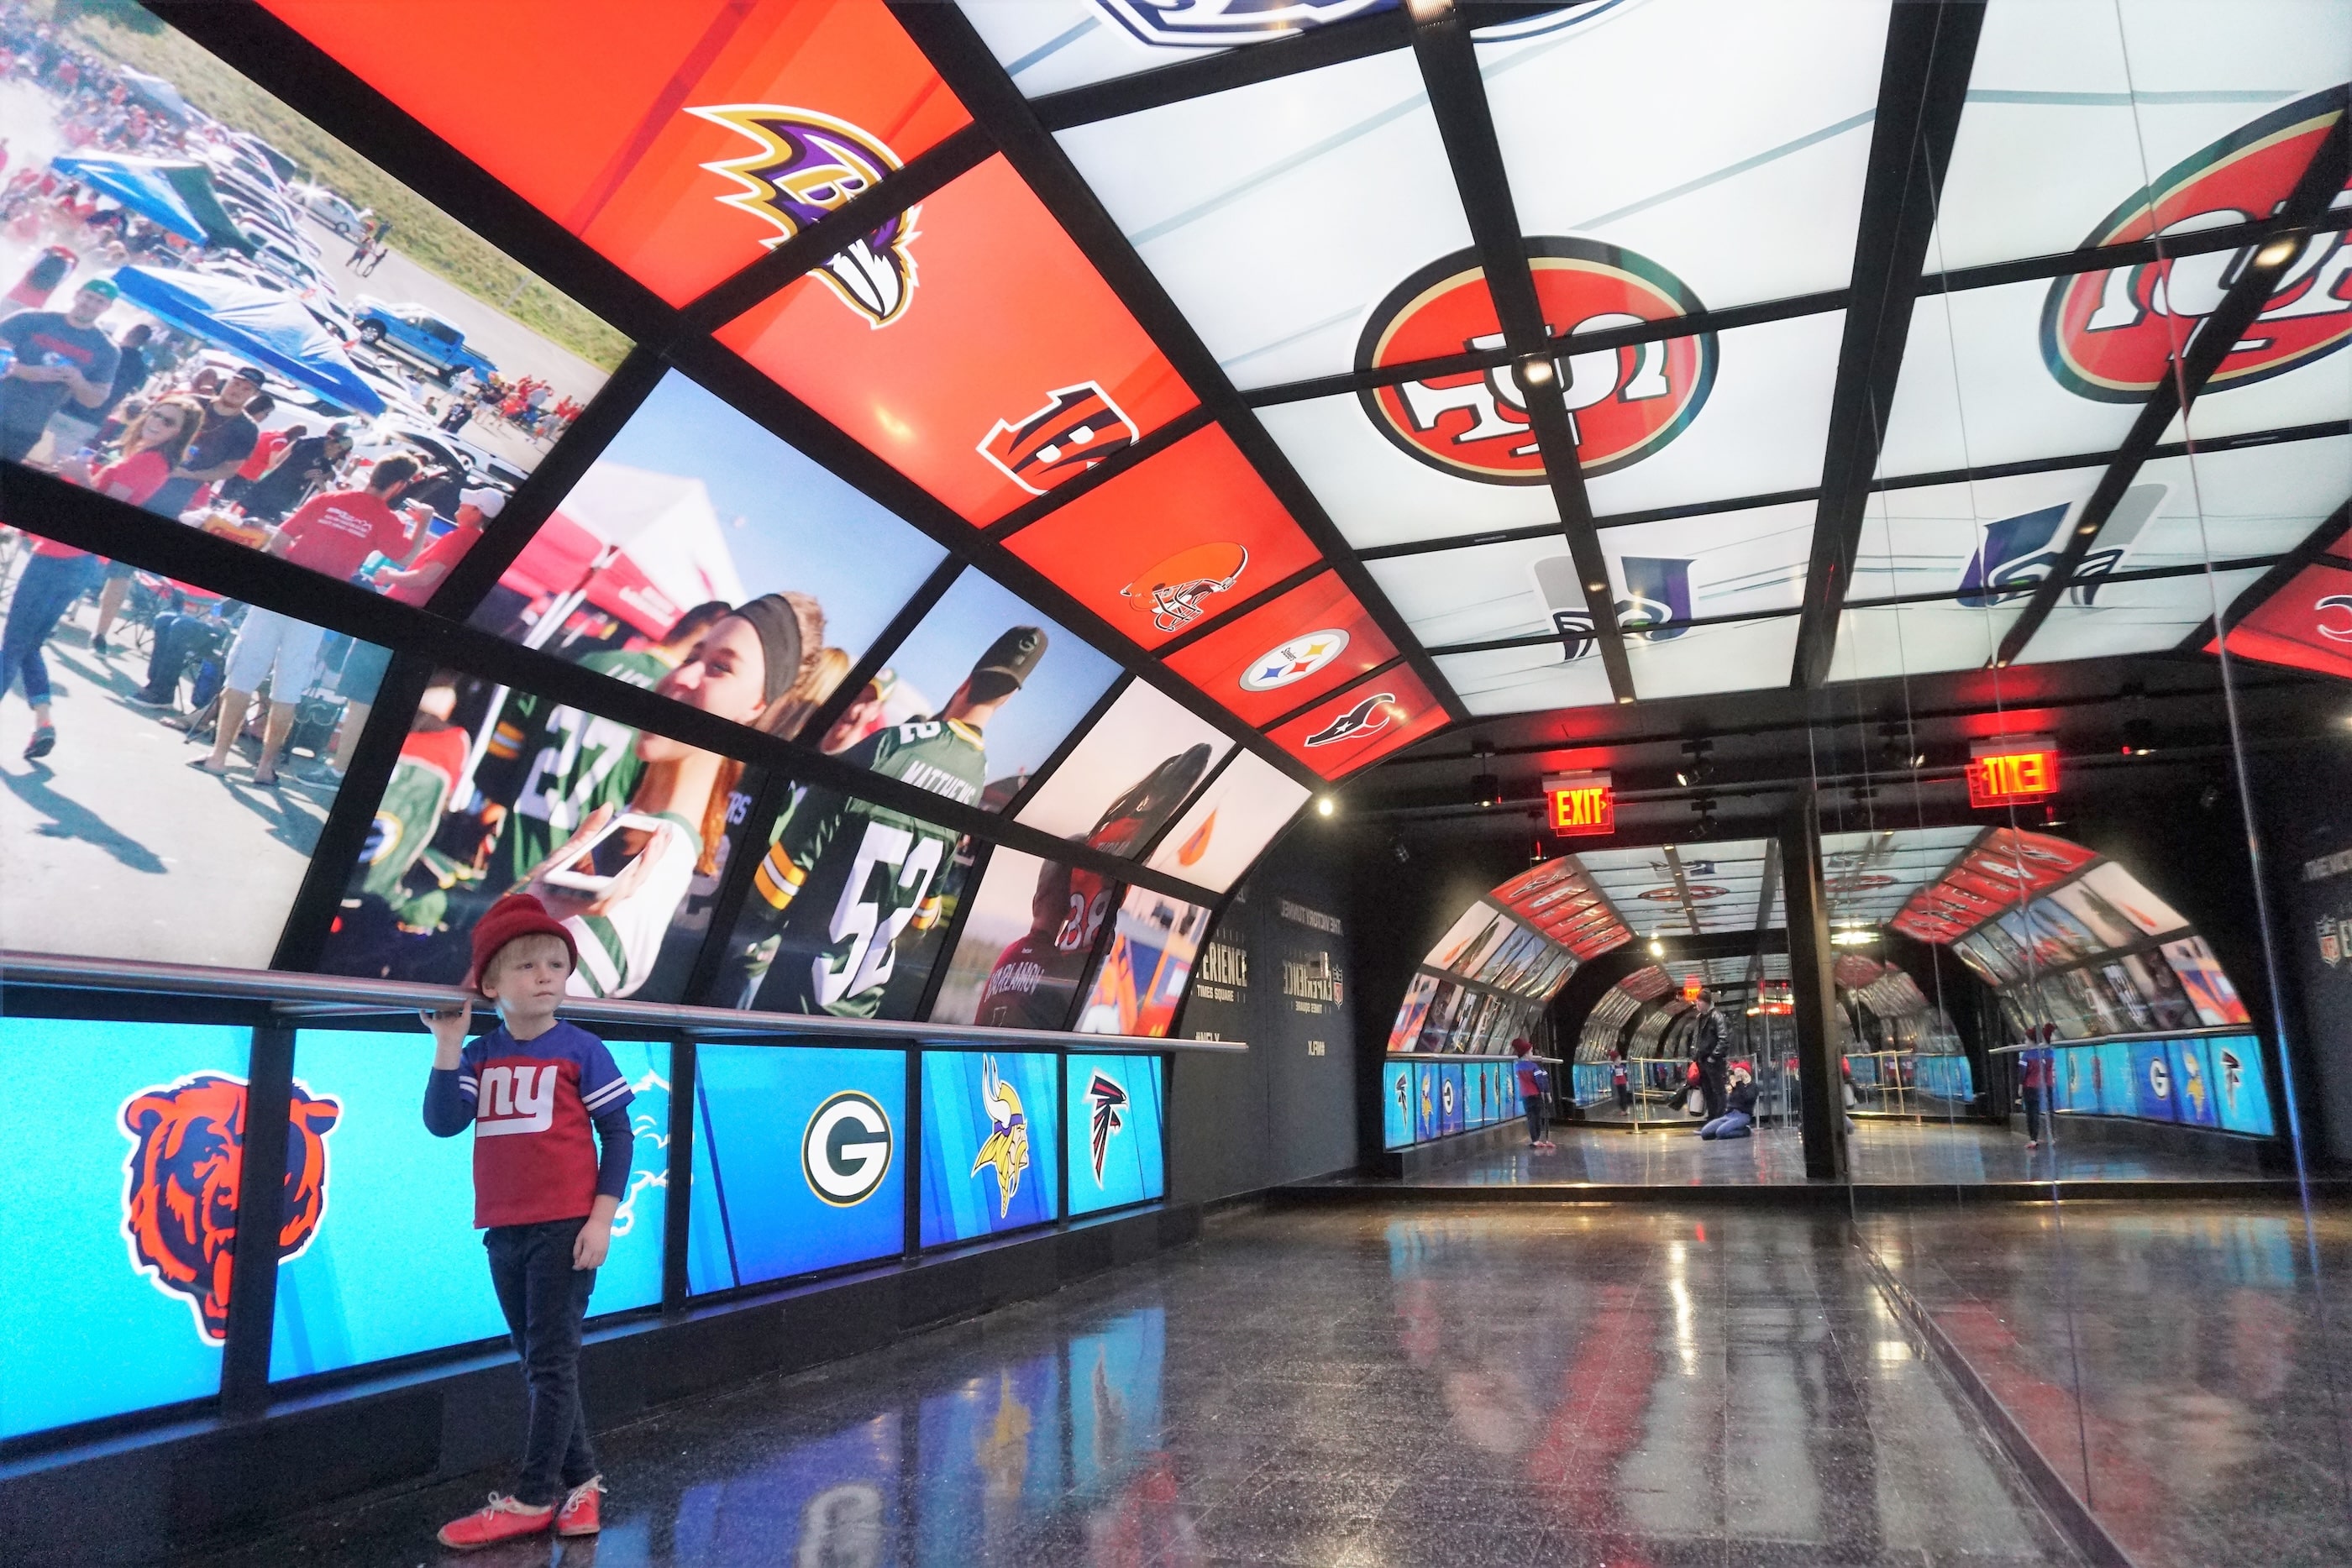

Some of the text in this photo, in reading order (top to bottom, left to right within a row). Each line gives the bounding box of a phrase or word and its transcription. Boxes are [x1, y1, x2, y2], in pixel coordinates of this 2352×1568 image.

[513, 704, 633, 831] 27
[1557, 789, 1604, 826] EXIT
[811, 821, 944, 1007] 52
[1195, 941, 1248, 988] ERIENCE
[1196, 984, 1235, 1003] TIMES SQUARE
[807, 1100, 888, 1197] G
